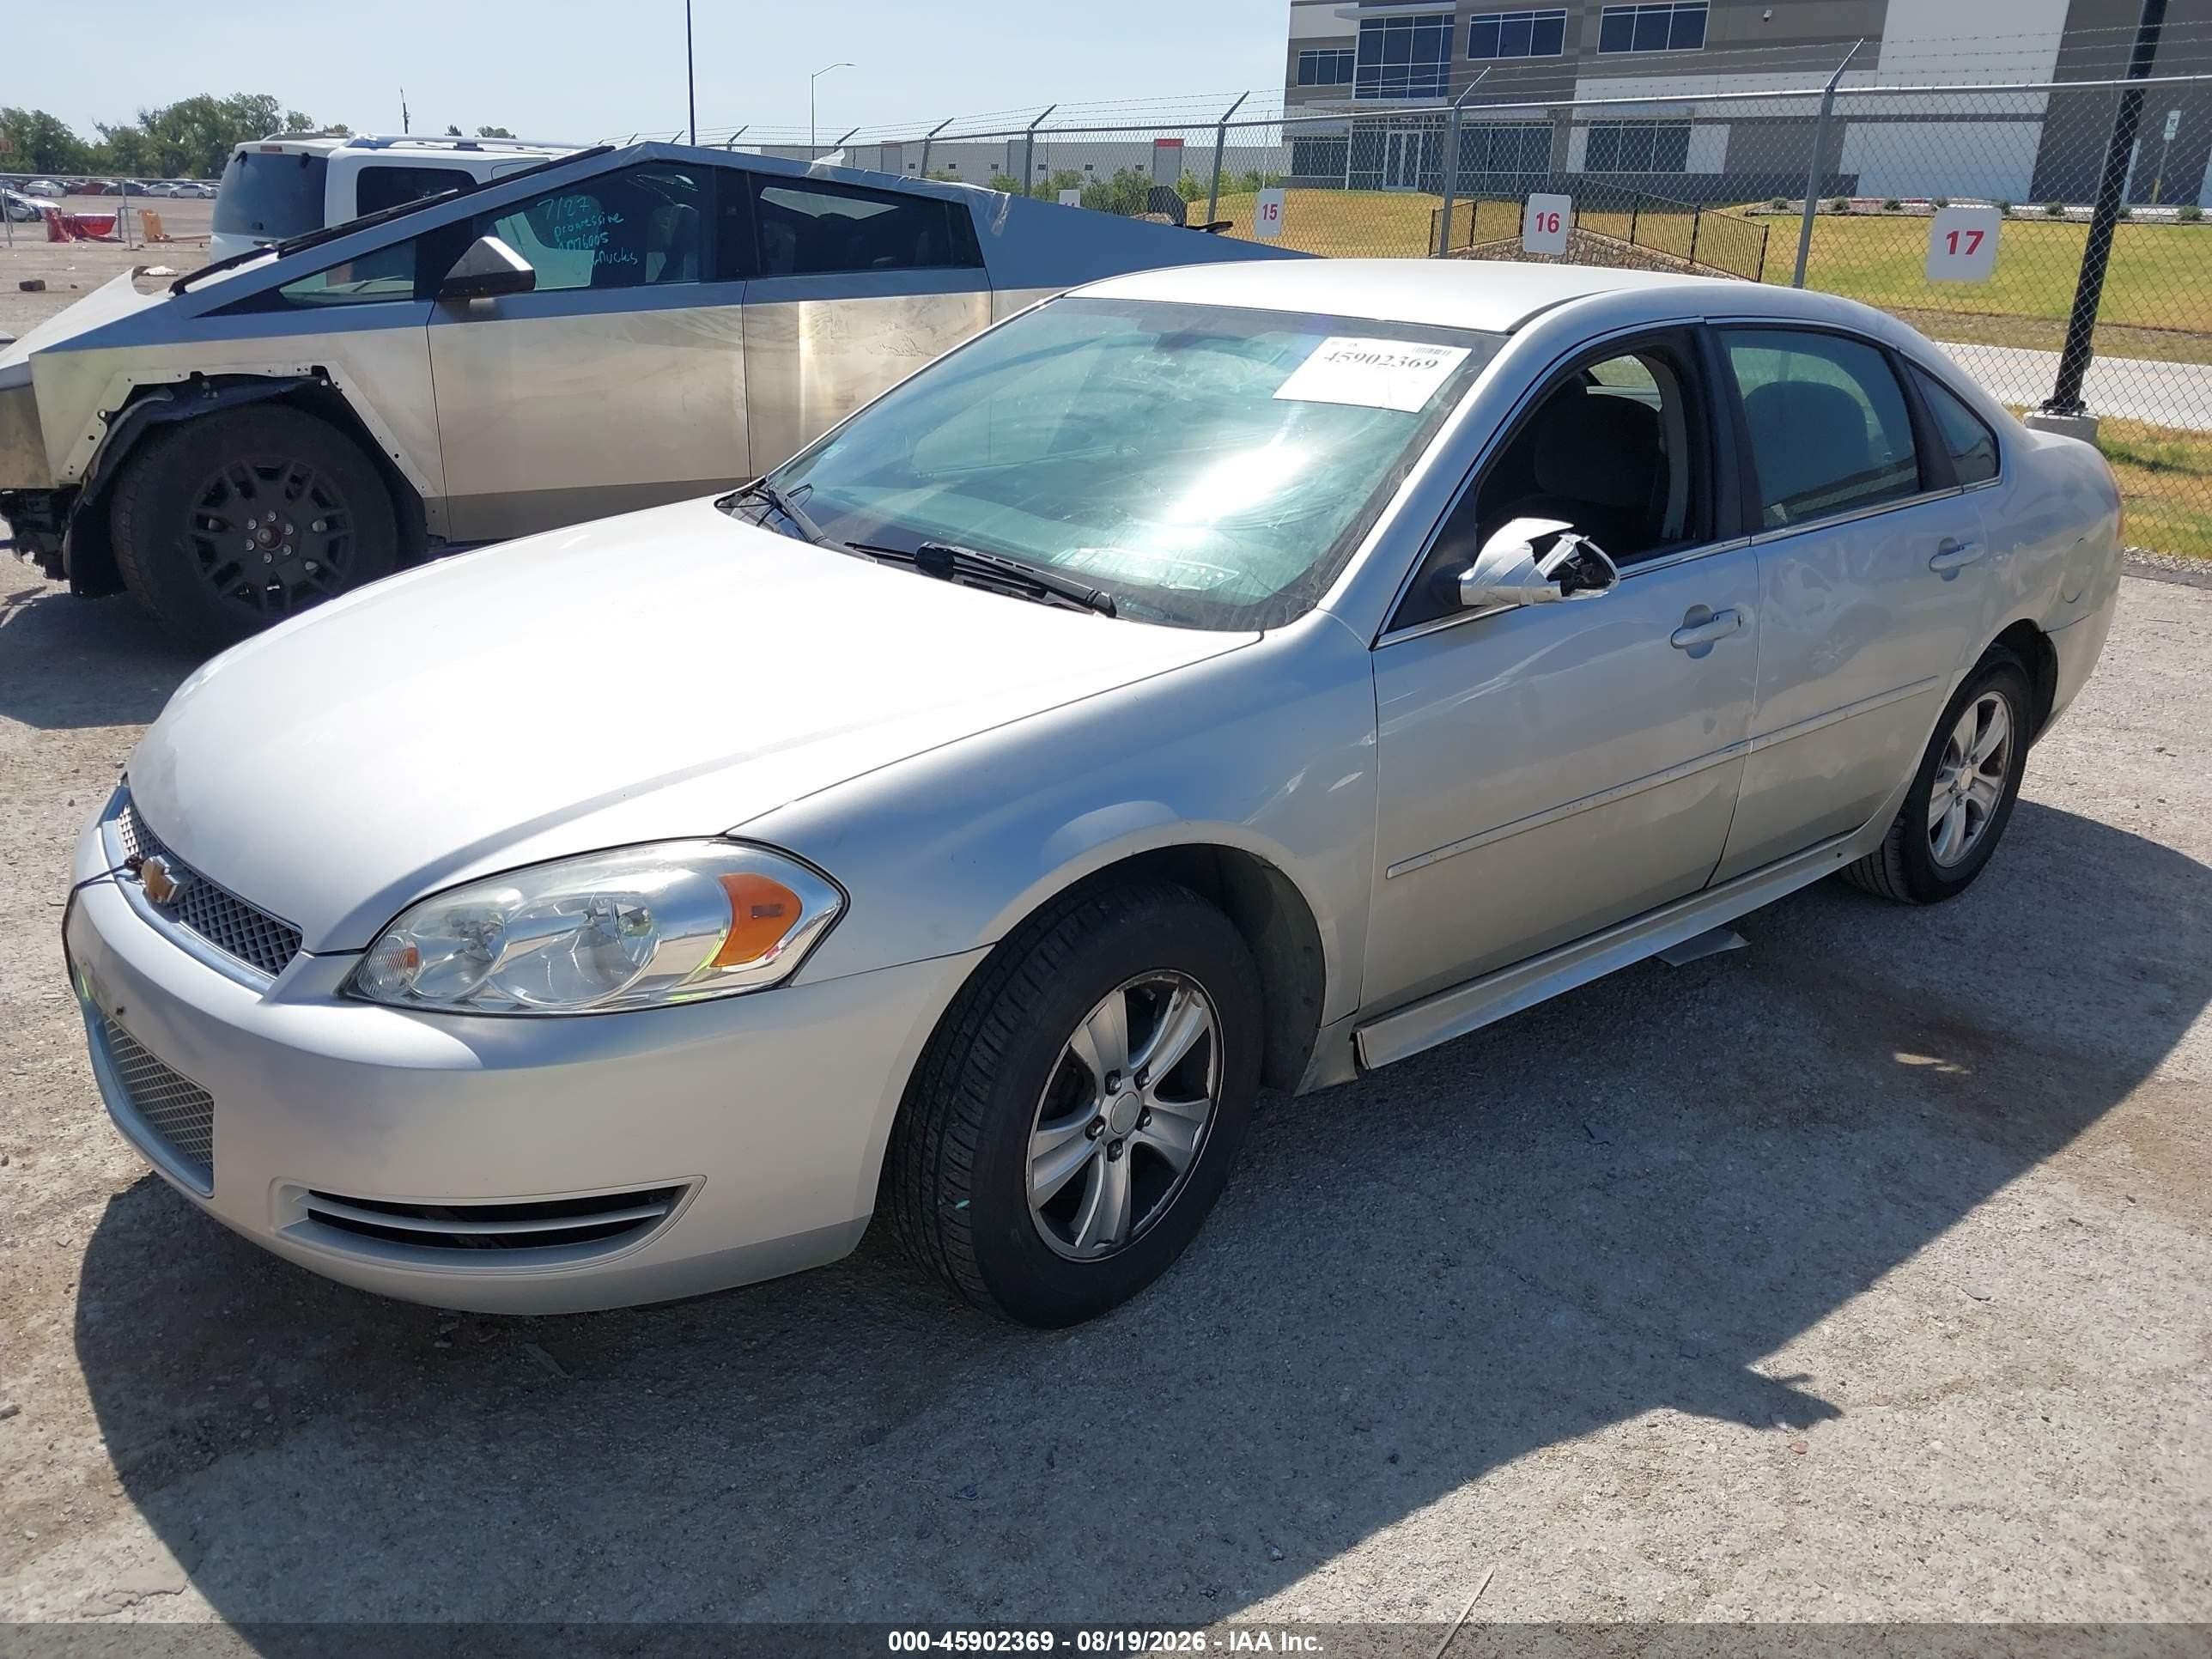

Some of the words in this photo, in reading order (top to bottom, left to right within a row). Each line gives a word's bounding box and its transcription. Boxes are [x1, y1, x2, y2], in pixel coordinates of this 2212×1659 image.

[1263, 204, 1279, 221] 15
[1536, 212, 1560, 234] 16
[1946, 230, 1984, 255] 17
[1323, 350, 1439, 370] 45902369
